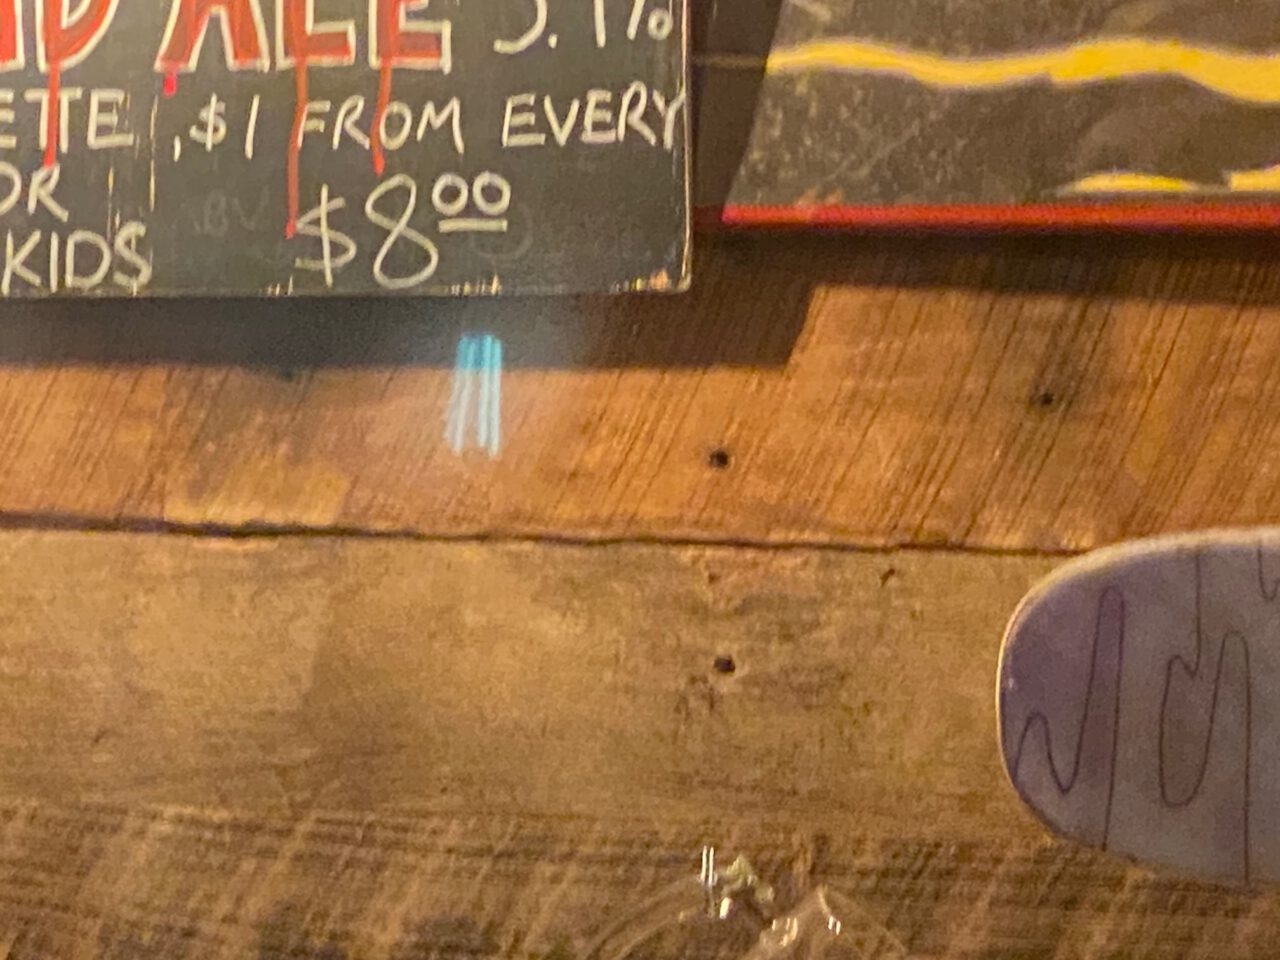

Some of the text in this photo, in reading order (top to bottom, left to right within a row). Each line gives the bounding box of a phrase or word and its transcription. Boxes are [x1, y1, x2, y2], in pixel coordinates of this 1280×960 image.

[297, 95, 465, 155] FROM
[501, 80, 685, 150] EVERY
[1, 222, 153, 296] KIDS
